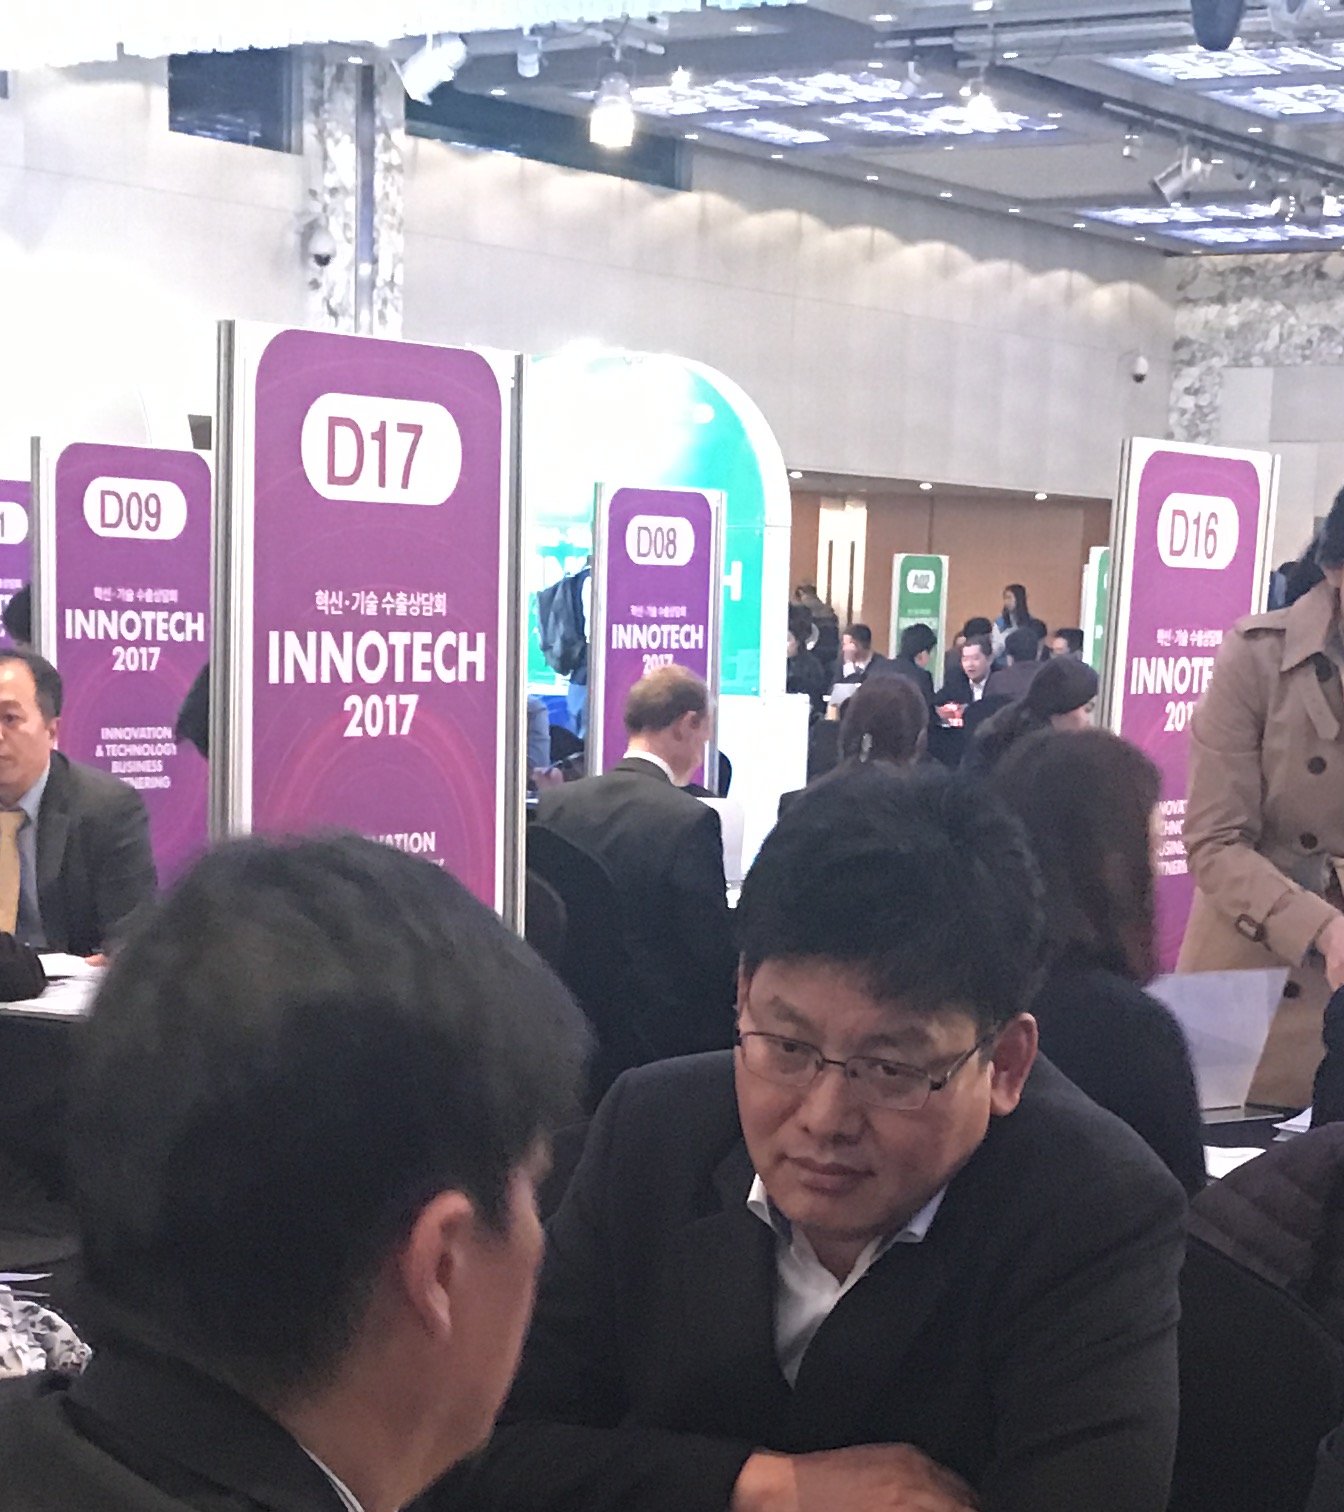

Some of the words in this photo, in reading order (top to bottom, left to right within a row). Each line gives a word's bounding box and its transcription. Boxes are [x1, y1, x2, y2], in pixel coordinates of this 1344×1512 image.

[327, 416, 424, 490] D17
[100, 490, 162, 532] D09
[637, 526, 678, 560] D08
[1169, 510, 1219, 560] D16
[315, 589, 379, 616] 혁신·기술
[64, 608, 205, 642] INNOTECH
[612, 623, 704, 650] INNOTECH
[112, 646, 161, 671] 2017
[268, 631, 486, 684] INNOTECH
[1130, 656, 1215, 695] INNOTE
[343, 694, 419, 738] 2017
[1163, 701, 1195, 732] 201
[101, 727, 172, 740] INNOVATION
[378, 831, 436, 854] ATION
